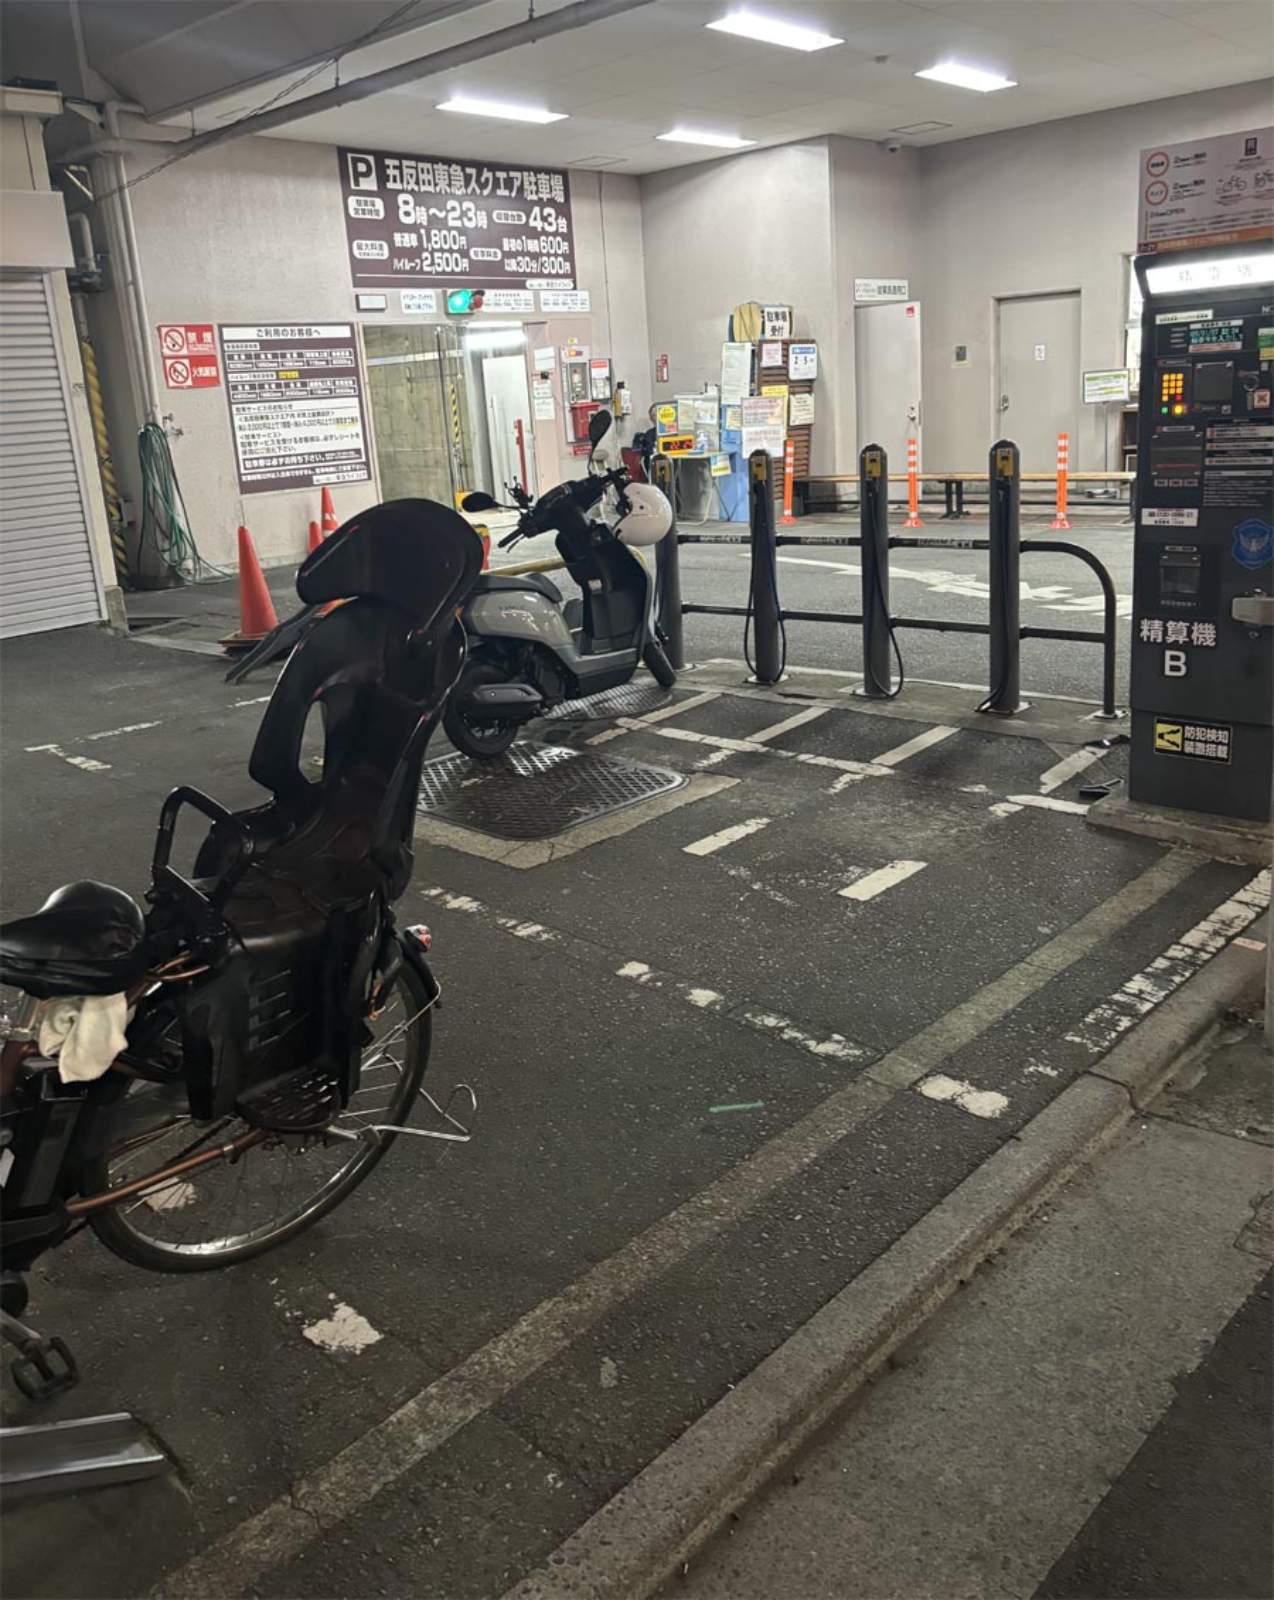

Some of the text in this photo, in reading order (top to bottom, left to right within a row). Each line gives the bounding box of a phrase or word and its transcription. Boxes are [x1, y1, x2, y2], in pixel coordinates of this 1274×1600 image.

[351, 157, 374, 188] P
[386, 158, 565, 203] 五反田東急スクエア駐車場
[529, 206, 567, 233] 43台
[766, 311, 788, 322] 駐車場
[256, 328, 320, 338] ご利用のお客様へ
[770, 325, 784, 337] 受付
[1140, 618, 1217, 647] 精算機
[1163, 650, 1187, 677] B
[1184, 725, 1229, 744] 防犯検知
